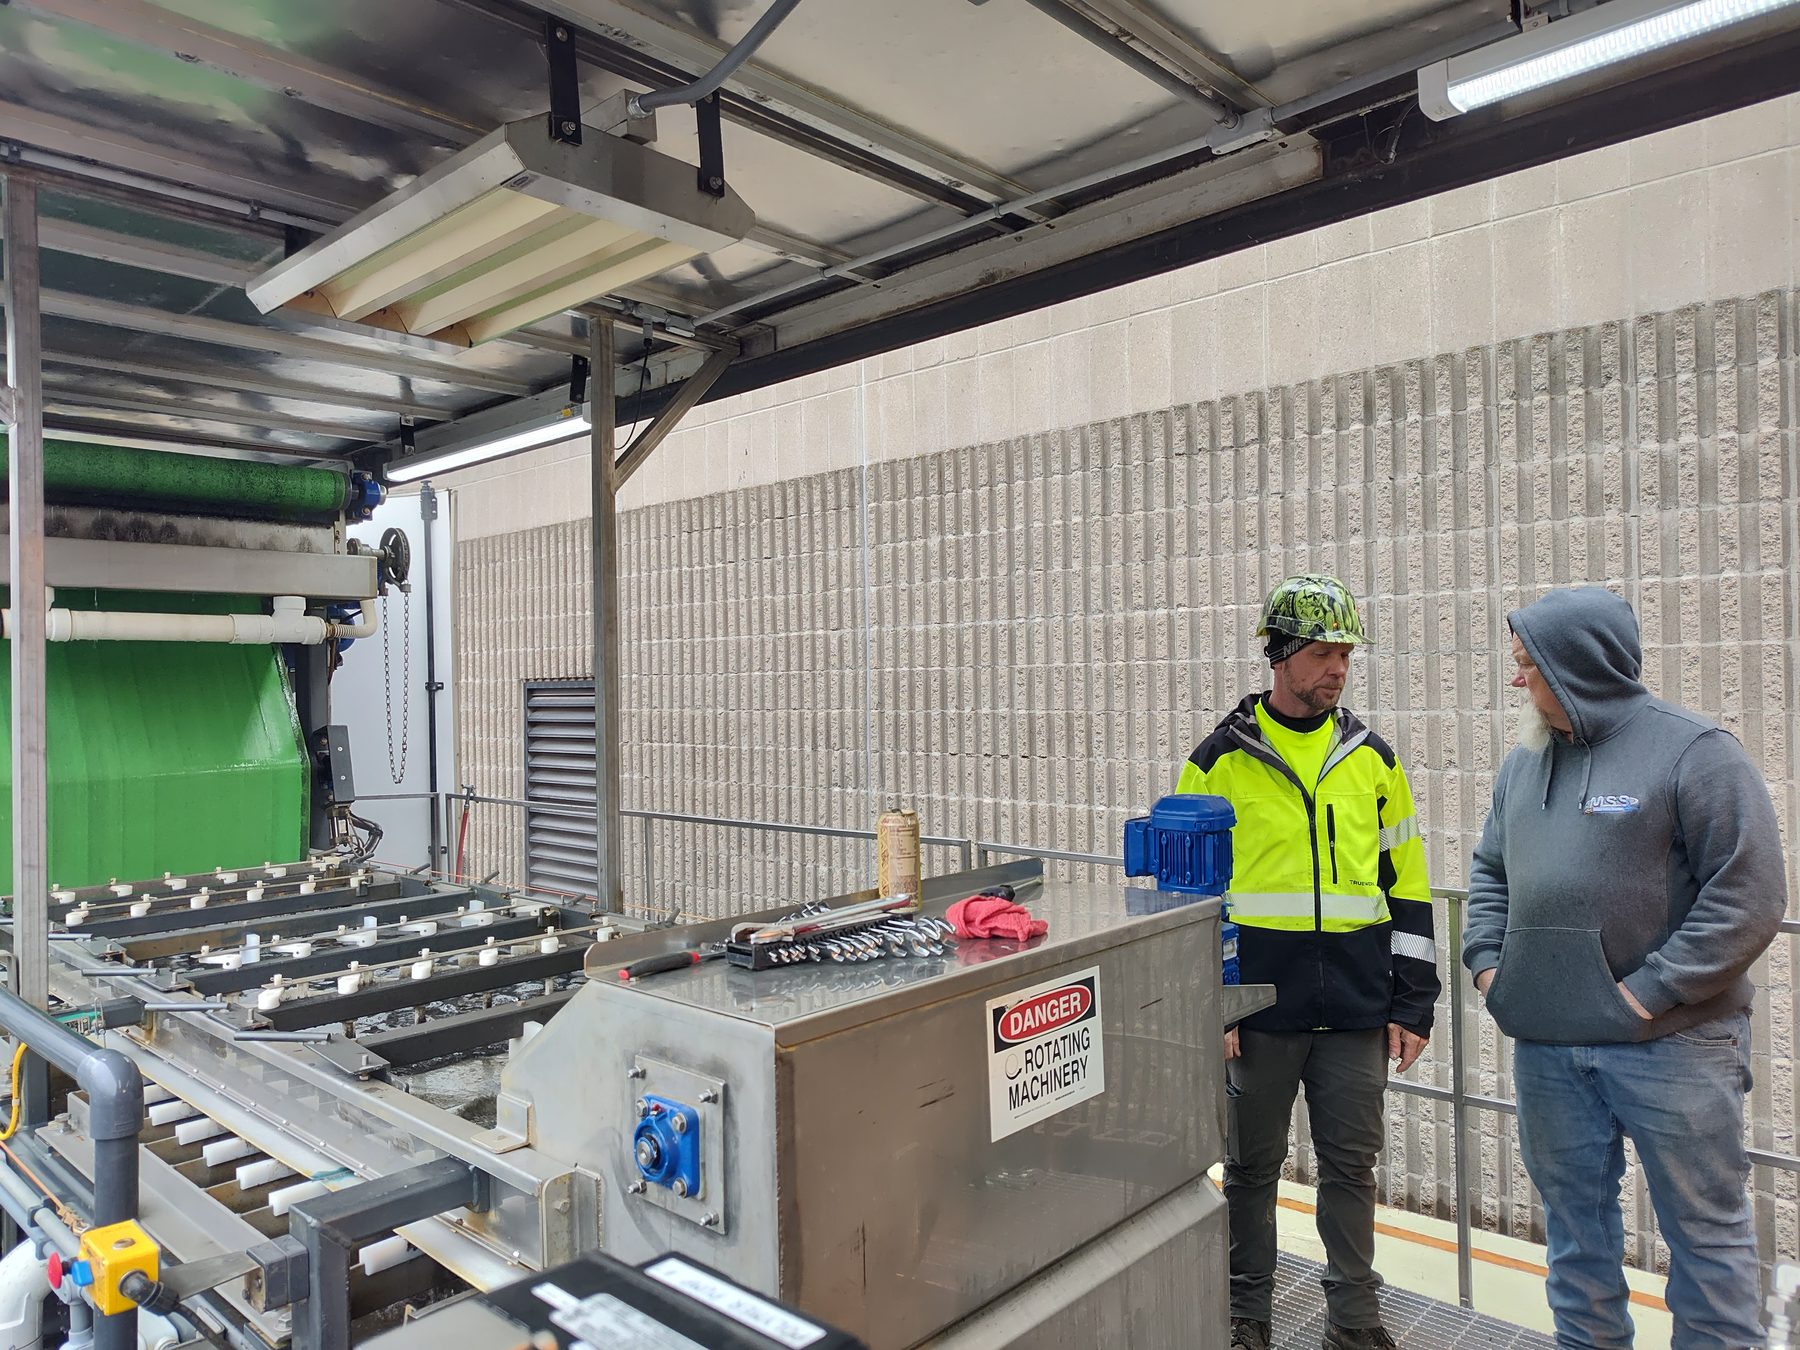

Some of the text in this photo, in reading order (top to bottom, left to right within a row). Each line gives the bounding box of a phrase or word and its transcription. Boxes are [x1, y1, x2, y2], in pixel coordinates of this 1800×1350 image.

[1010, 991, 1082, 1037] DANGER
[1025, 1027, 1091, 1074] ROTATING
[1008, 1055, 1089, 1111] MACHINERY
